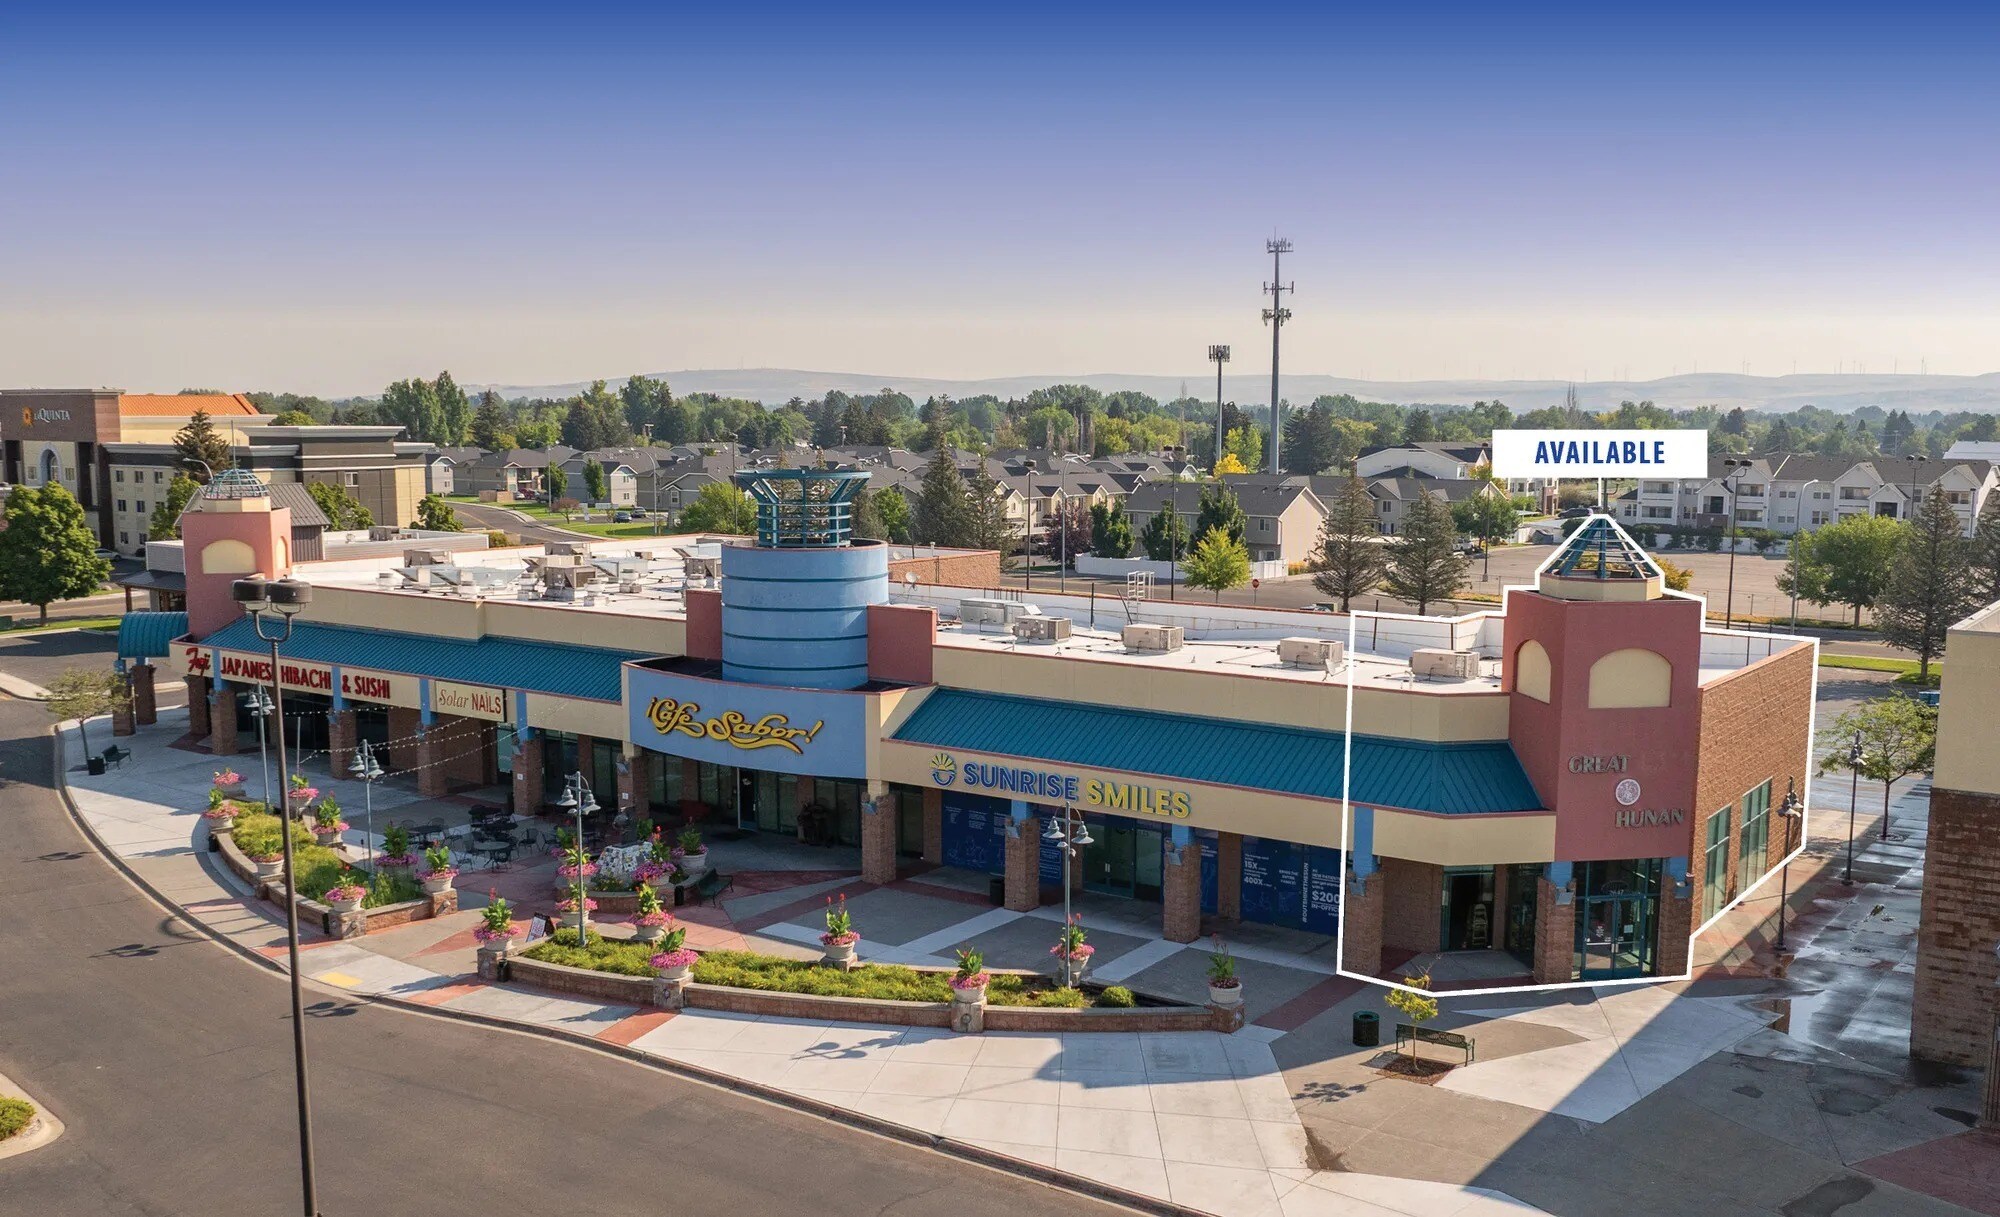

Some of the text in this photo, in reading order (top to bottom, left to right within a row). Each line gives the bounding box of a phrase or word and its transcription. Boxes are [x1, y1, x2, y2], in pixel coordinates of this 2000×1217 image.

[220, 656, 273, 681] JAPANES
[281, 665, 332, 690] HIBACHI
[342, 674, 351, 694] &
[354, 675, 390, 699] SUSHI
[440, 689, 469, 708] Solar
[1568, 755, 1629, 774] GREAT
[963, 762, 1191, 819] SUNRISE SMILES
[1615, 807, 1684, 828] HUNAN
[1311, 890, 1340, 904] $200
